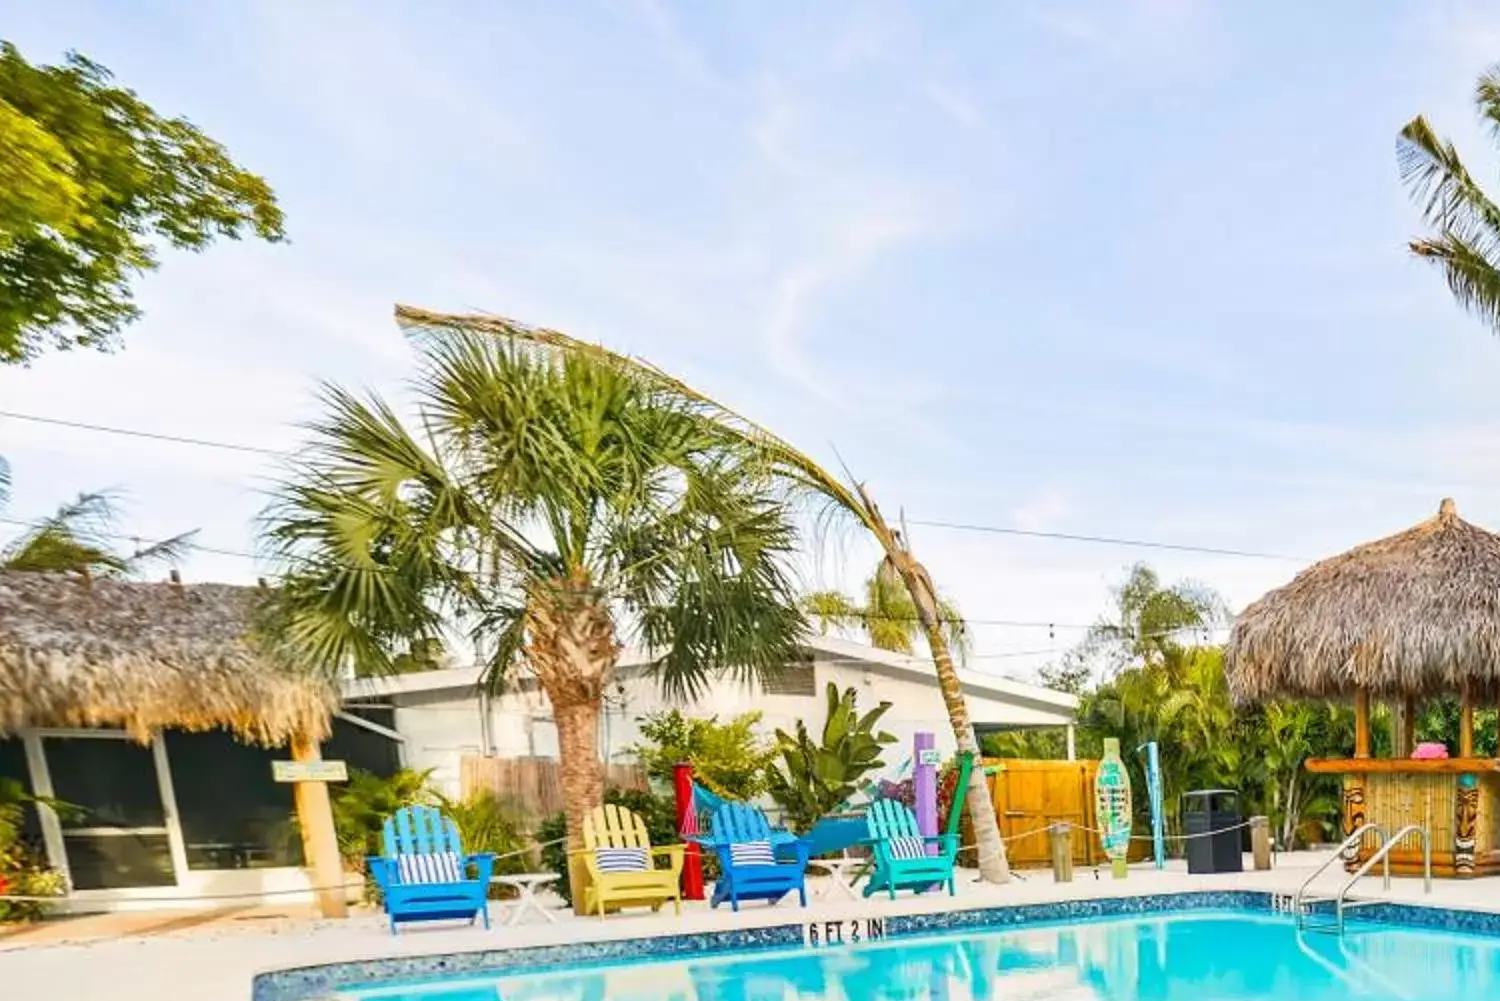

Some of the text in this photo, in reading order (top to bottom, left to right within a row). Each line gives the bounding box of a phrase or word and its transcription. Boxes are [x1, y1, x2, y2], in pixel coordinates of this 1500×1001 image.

[810, 918, 883, 944] 6 FT 2 IN
